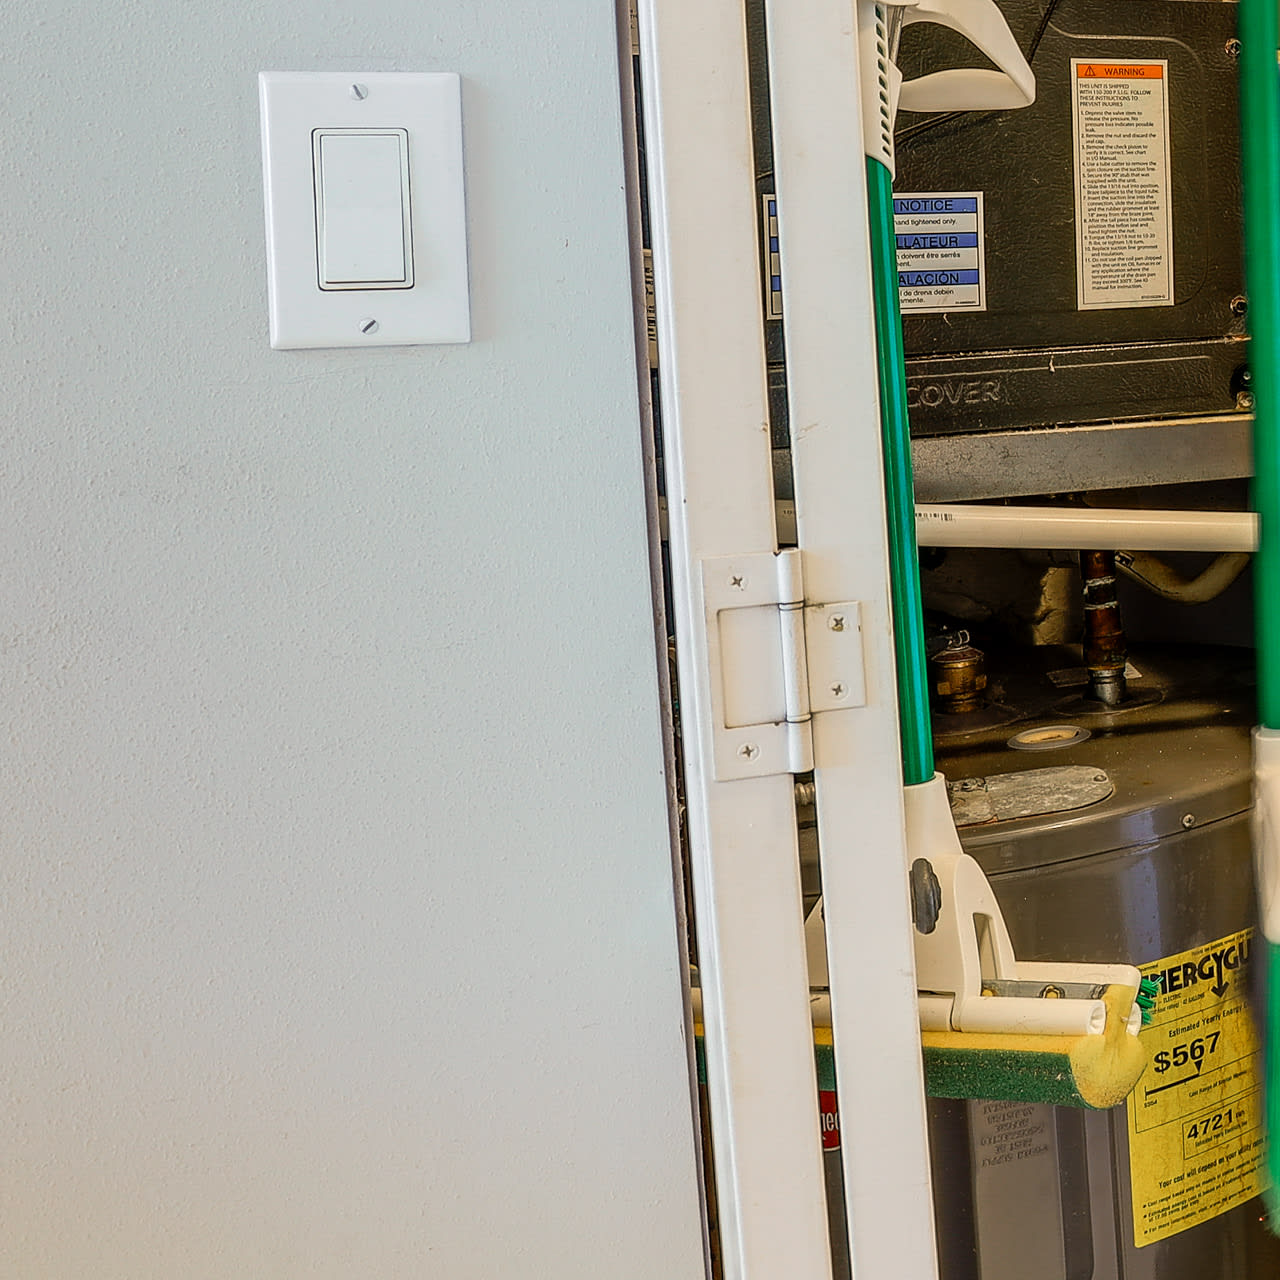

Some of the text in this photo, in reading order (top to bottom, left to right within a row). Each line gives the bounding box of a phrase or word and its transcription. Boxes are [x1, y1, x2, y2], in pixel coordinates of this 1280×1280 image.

[1104, 68, 1145, 77] WARNING
[900, 200, 953, 211] NOTICE
[911, 218, 957, 227] tightened only.
[901, 251, 925, 259] doivent
[940, 251, 961, 259] serrés
[907, 380, 1001, 407] COVER
[1168, 1020, 1200, 1038] Estimated
[1202, 1011, 1221, 1026] Yearly
[1153, 1031, 1221, 1074] $567
[1187, 1109, 1233, 1139] 4721
[1159, 1178, 1172, 1189] Your
[1174, 1173, 1185, 1184] cost
[1187, 1168, 1197, 1178] will
[1198, 1160, 1217, 1174] depend
[1225, 1151, 1237, 1164] your
